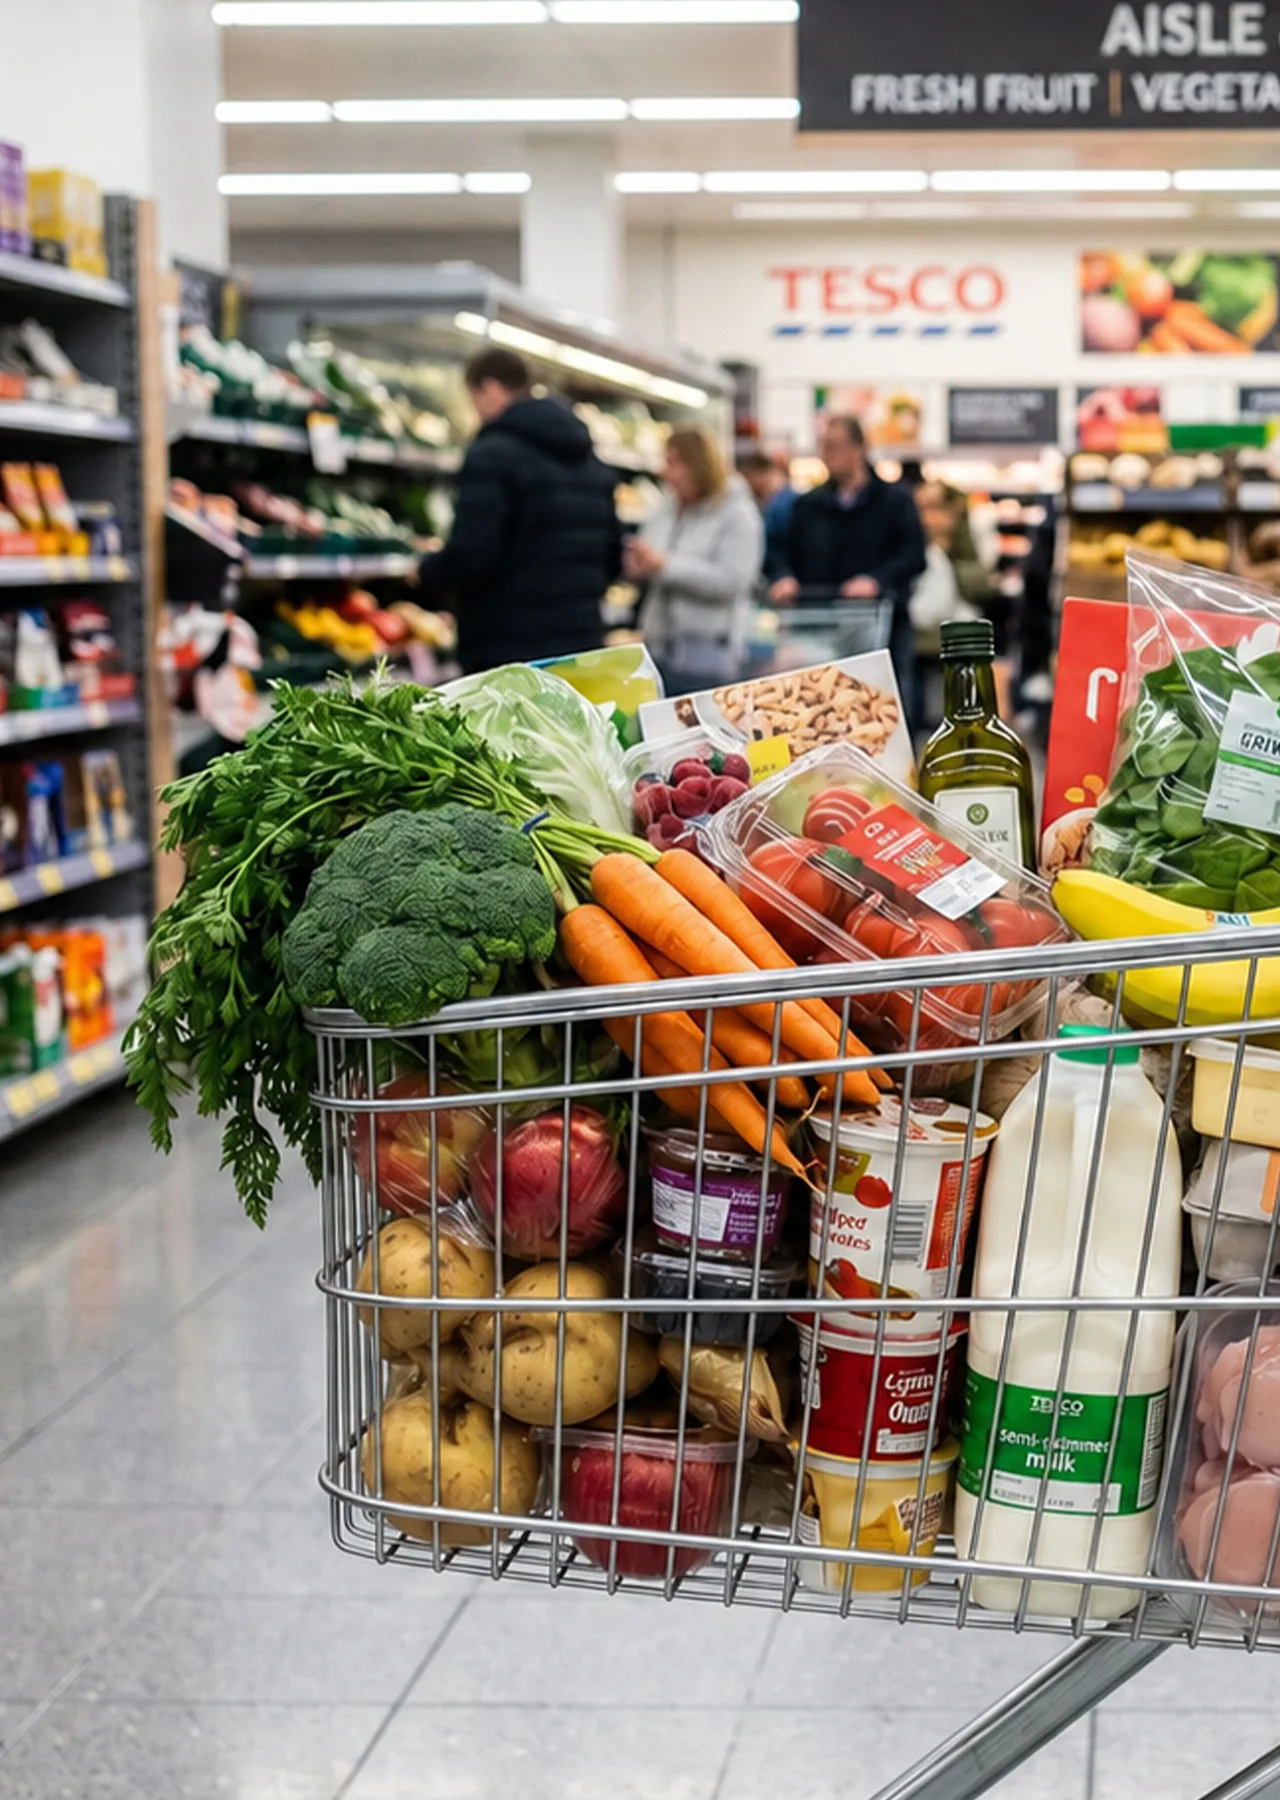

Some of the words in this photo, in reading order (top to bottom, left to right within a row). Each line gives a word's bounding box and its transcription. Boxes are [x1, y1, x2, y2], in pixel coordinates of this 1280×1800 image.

[1100, 1, 1268, 57] AISLE
[850, 73, 977, 115] FRESH
[983, 73, 1099, 115] FRUIT
[765, 264, 1007, 316] TESCO
[1030, 1395, 1084, 1413] TECO
[1025, 1452, 1076, 1473] milk
